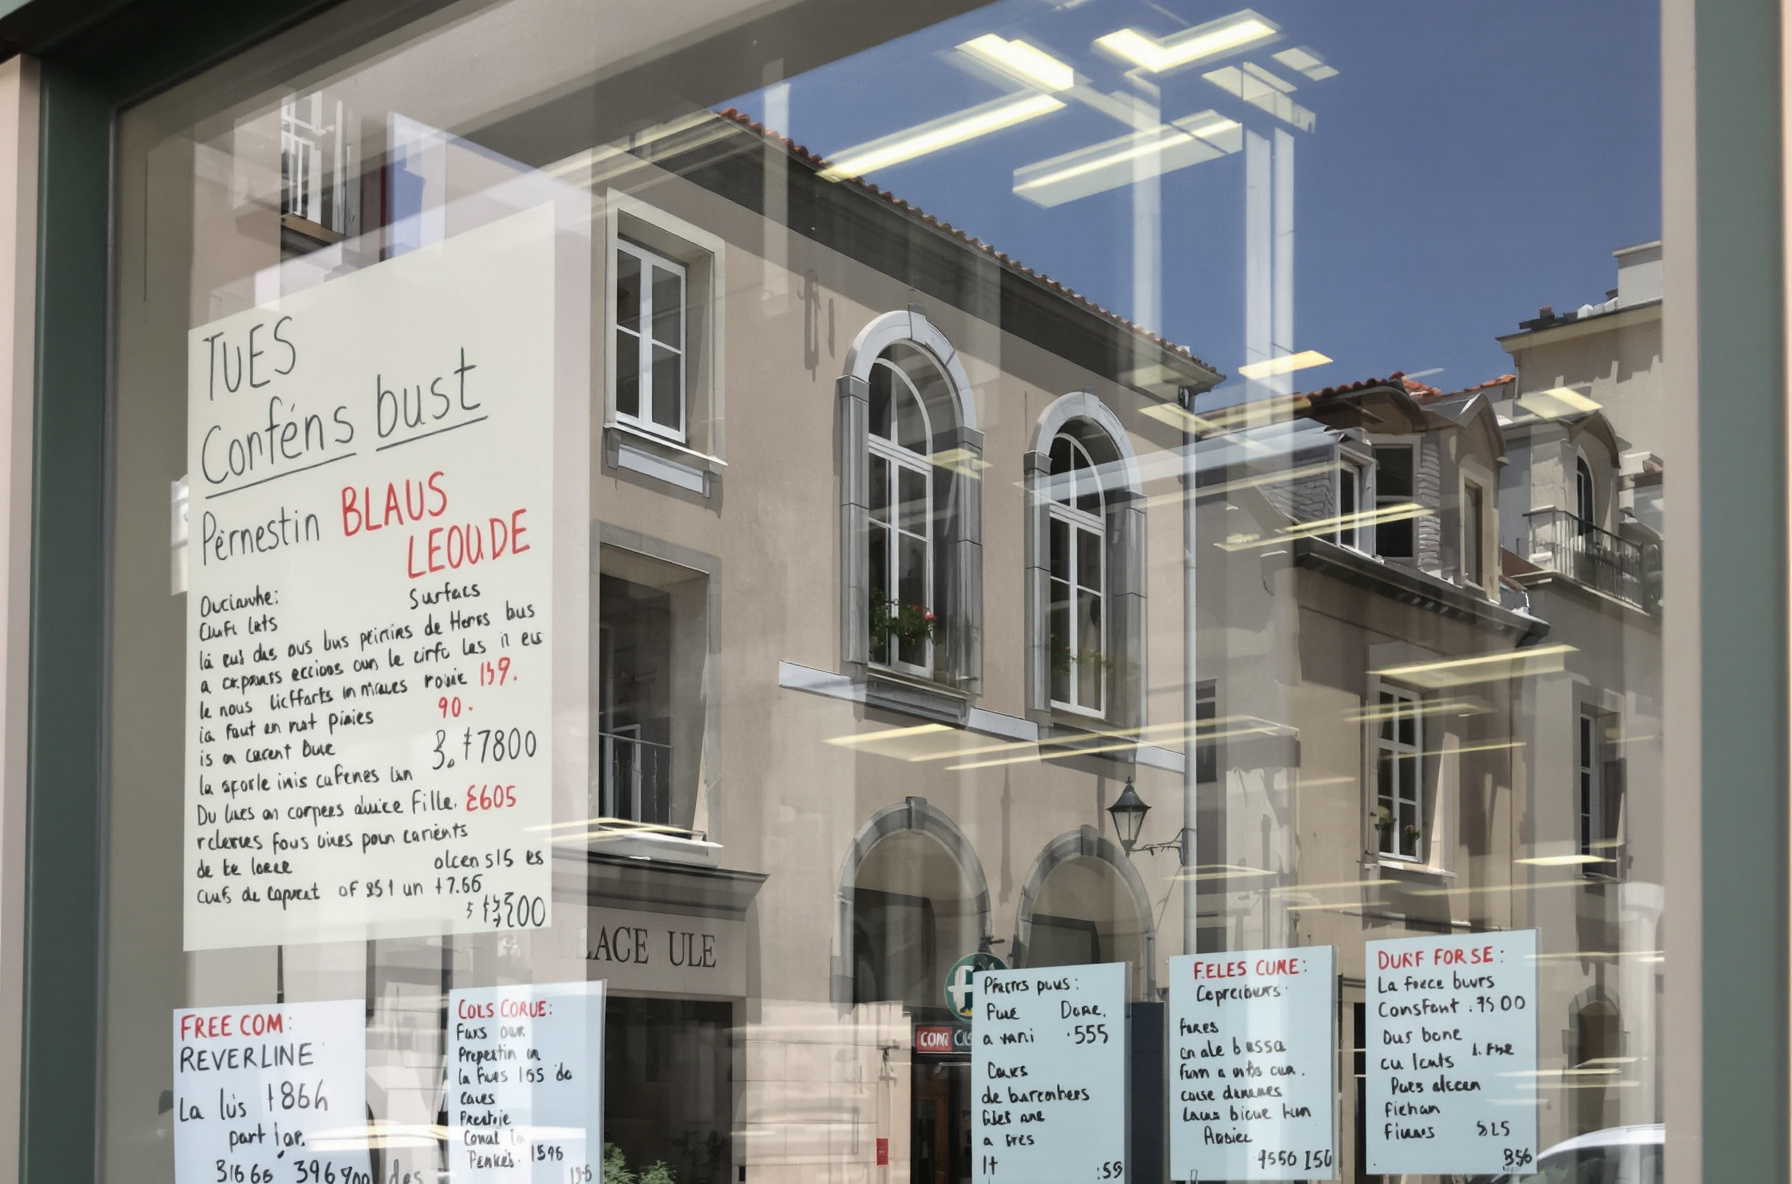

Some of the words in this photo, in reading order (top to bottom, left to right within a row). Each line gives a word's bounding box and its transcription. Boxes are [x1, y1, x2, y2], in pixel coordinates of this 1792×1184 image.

[202, 316, 297, 401] TUES
[376, 346, 481, 438] bust
[342, 471, 448, 537] BLAUS
[407, 508, 531, 579] LEOUDE
[585, 925, 650, 965] ACE
[667, 930, 717, 968] ULE
[1378, 975, 1399, 994] La
[180, 1013, 233, 1041] FREE
[179, 1096, 205, 1122] La
